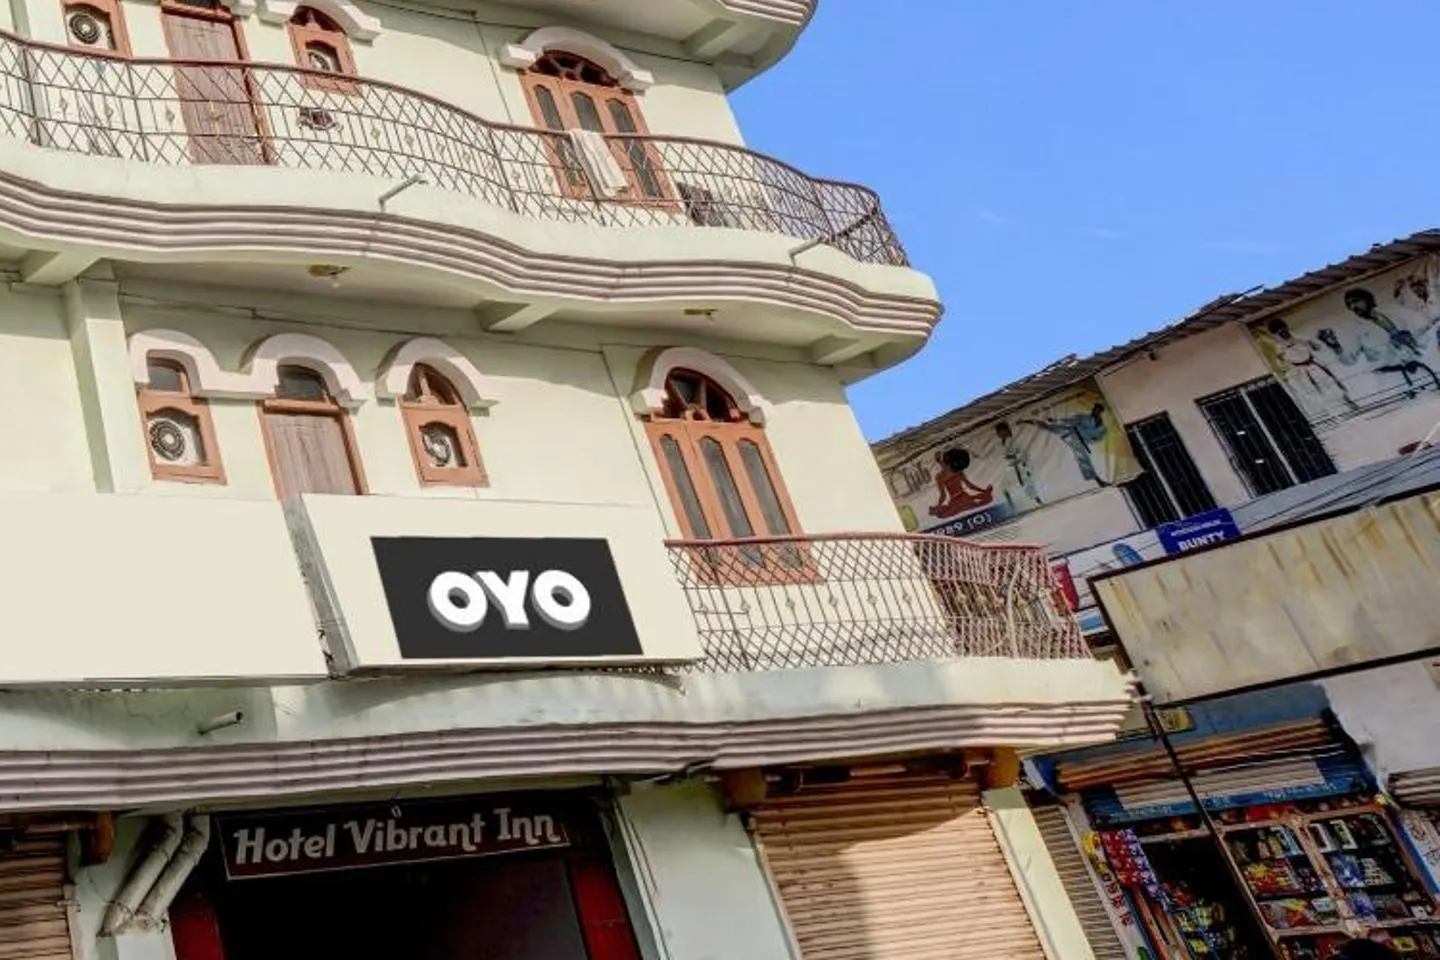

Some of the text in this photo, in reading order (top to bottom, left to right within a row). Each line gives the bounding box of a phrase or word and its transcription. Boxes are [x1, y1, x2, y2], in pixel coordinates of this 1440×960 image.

[1177, 530, 1224, 552] BUNTY
[426, 569, 592, 633] OYO
[233, 807, 562, 865] Hotel Vibrant Inn
